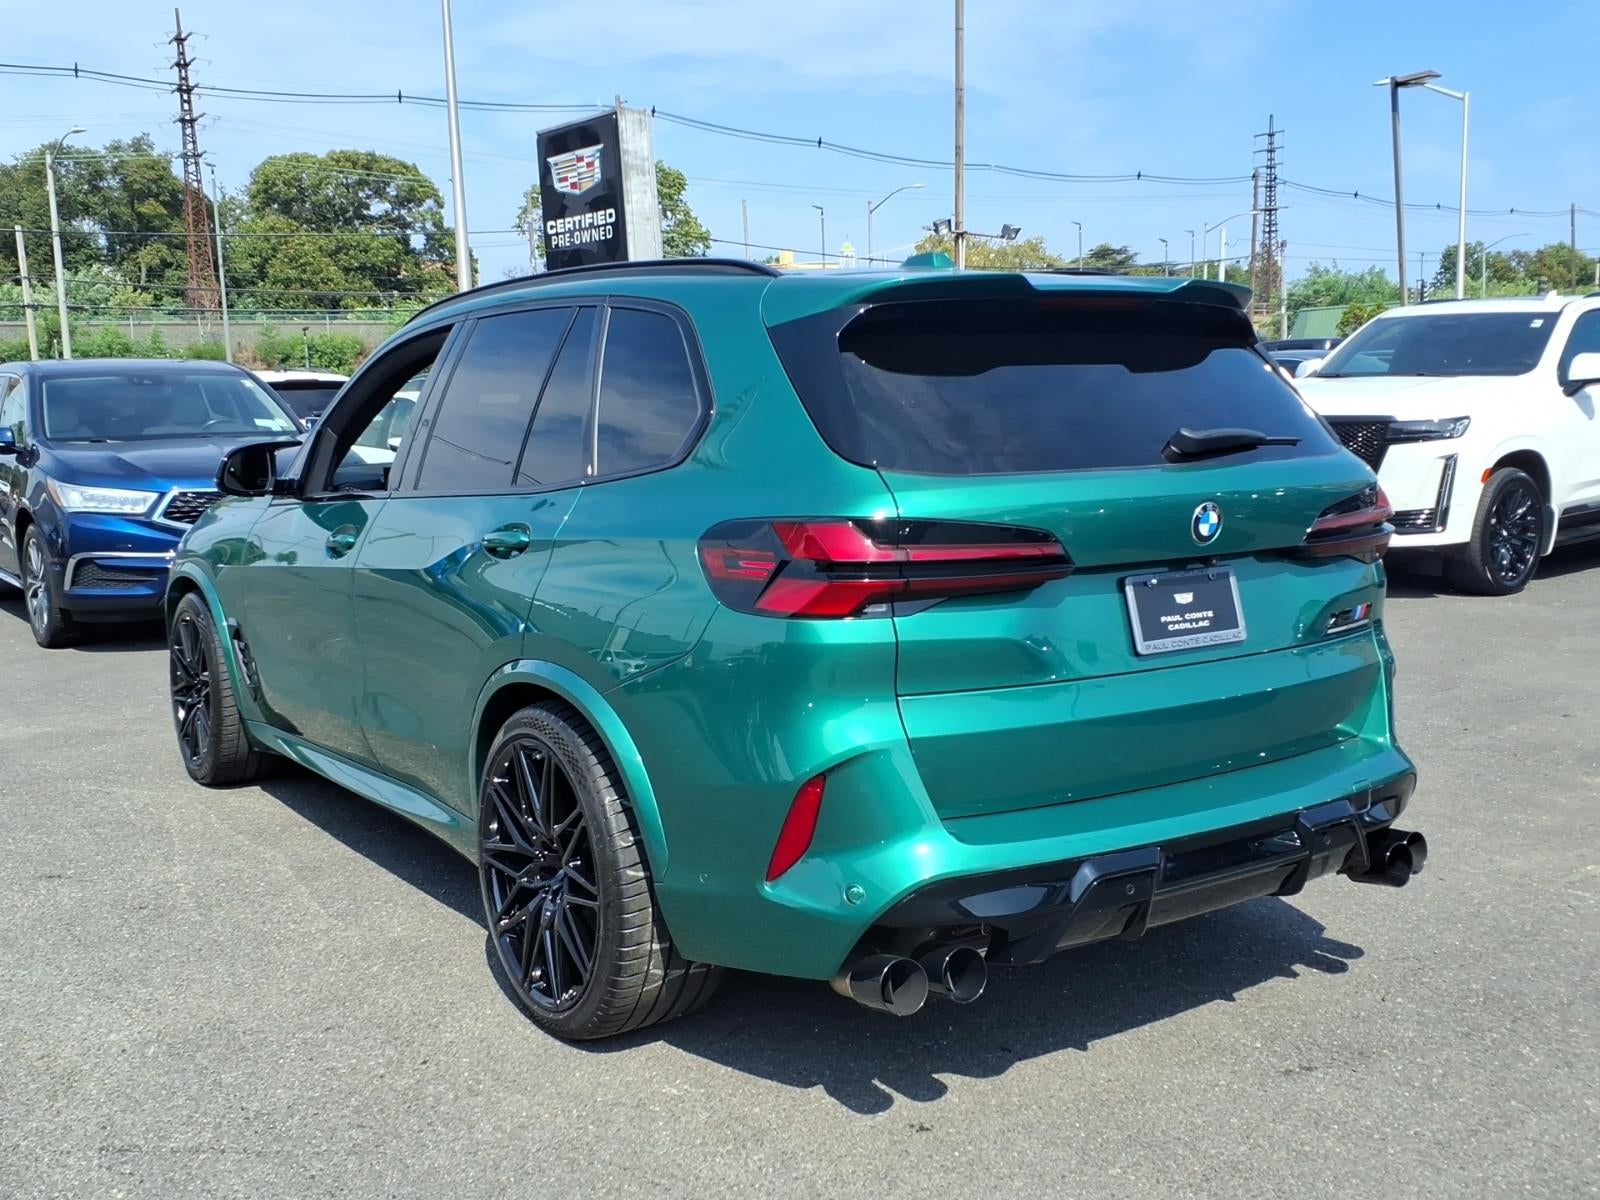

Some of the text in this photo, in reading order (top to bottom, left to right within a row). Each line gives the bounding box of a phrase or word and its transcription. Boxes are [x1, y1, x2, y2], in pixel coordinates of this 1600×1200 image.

[546, 208, 616, 235] CERTIFIED
[551, 225, 614, 249] PRE-OWNED
[1160, 610, 1214, 623] PAUL CONTE
[1167, 619, 1211, 631] CADILLAC
[1145, 642, 1169, 651] PAUL
[1171, 637, 1201, 648] CONTE
